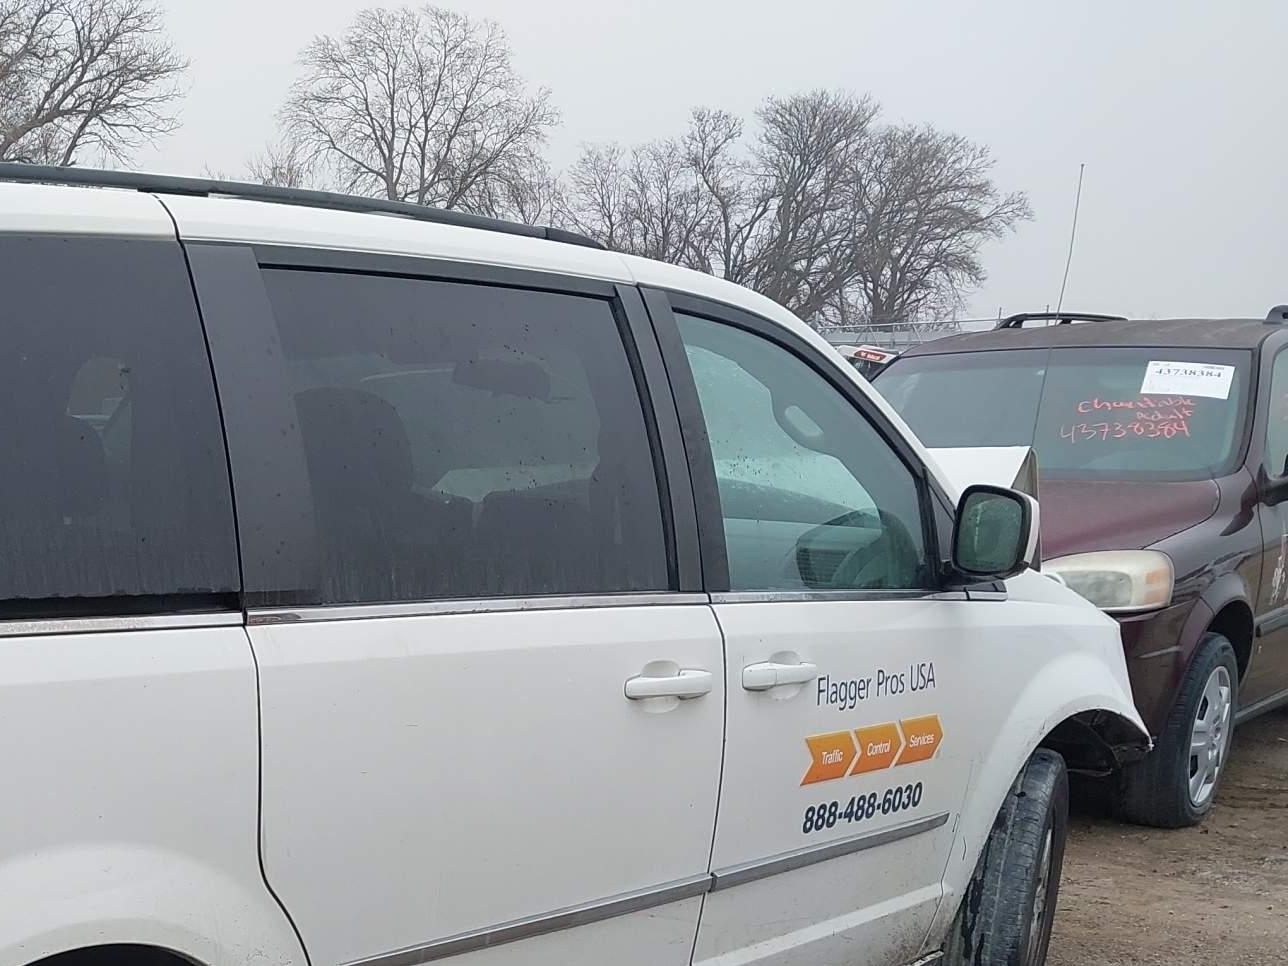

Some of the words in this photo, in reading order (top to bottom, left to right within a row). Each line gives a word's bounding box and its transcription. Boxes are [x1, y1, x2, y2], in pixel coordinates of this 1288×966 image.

[1060, 421, 1190, 443] 43738384
[817, 674, 872, 711] Flagger
[877, 669, 905, 697] Pros
[910, 662, 936, 692] USA
[822, 749, 844, 766] Traffic
[867, 739, 891, 757] Control
[909, 733, 935, 748] Services
[803, 781, 923, 834] 888-488-6030
